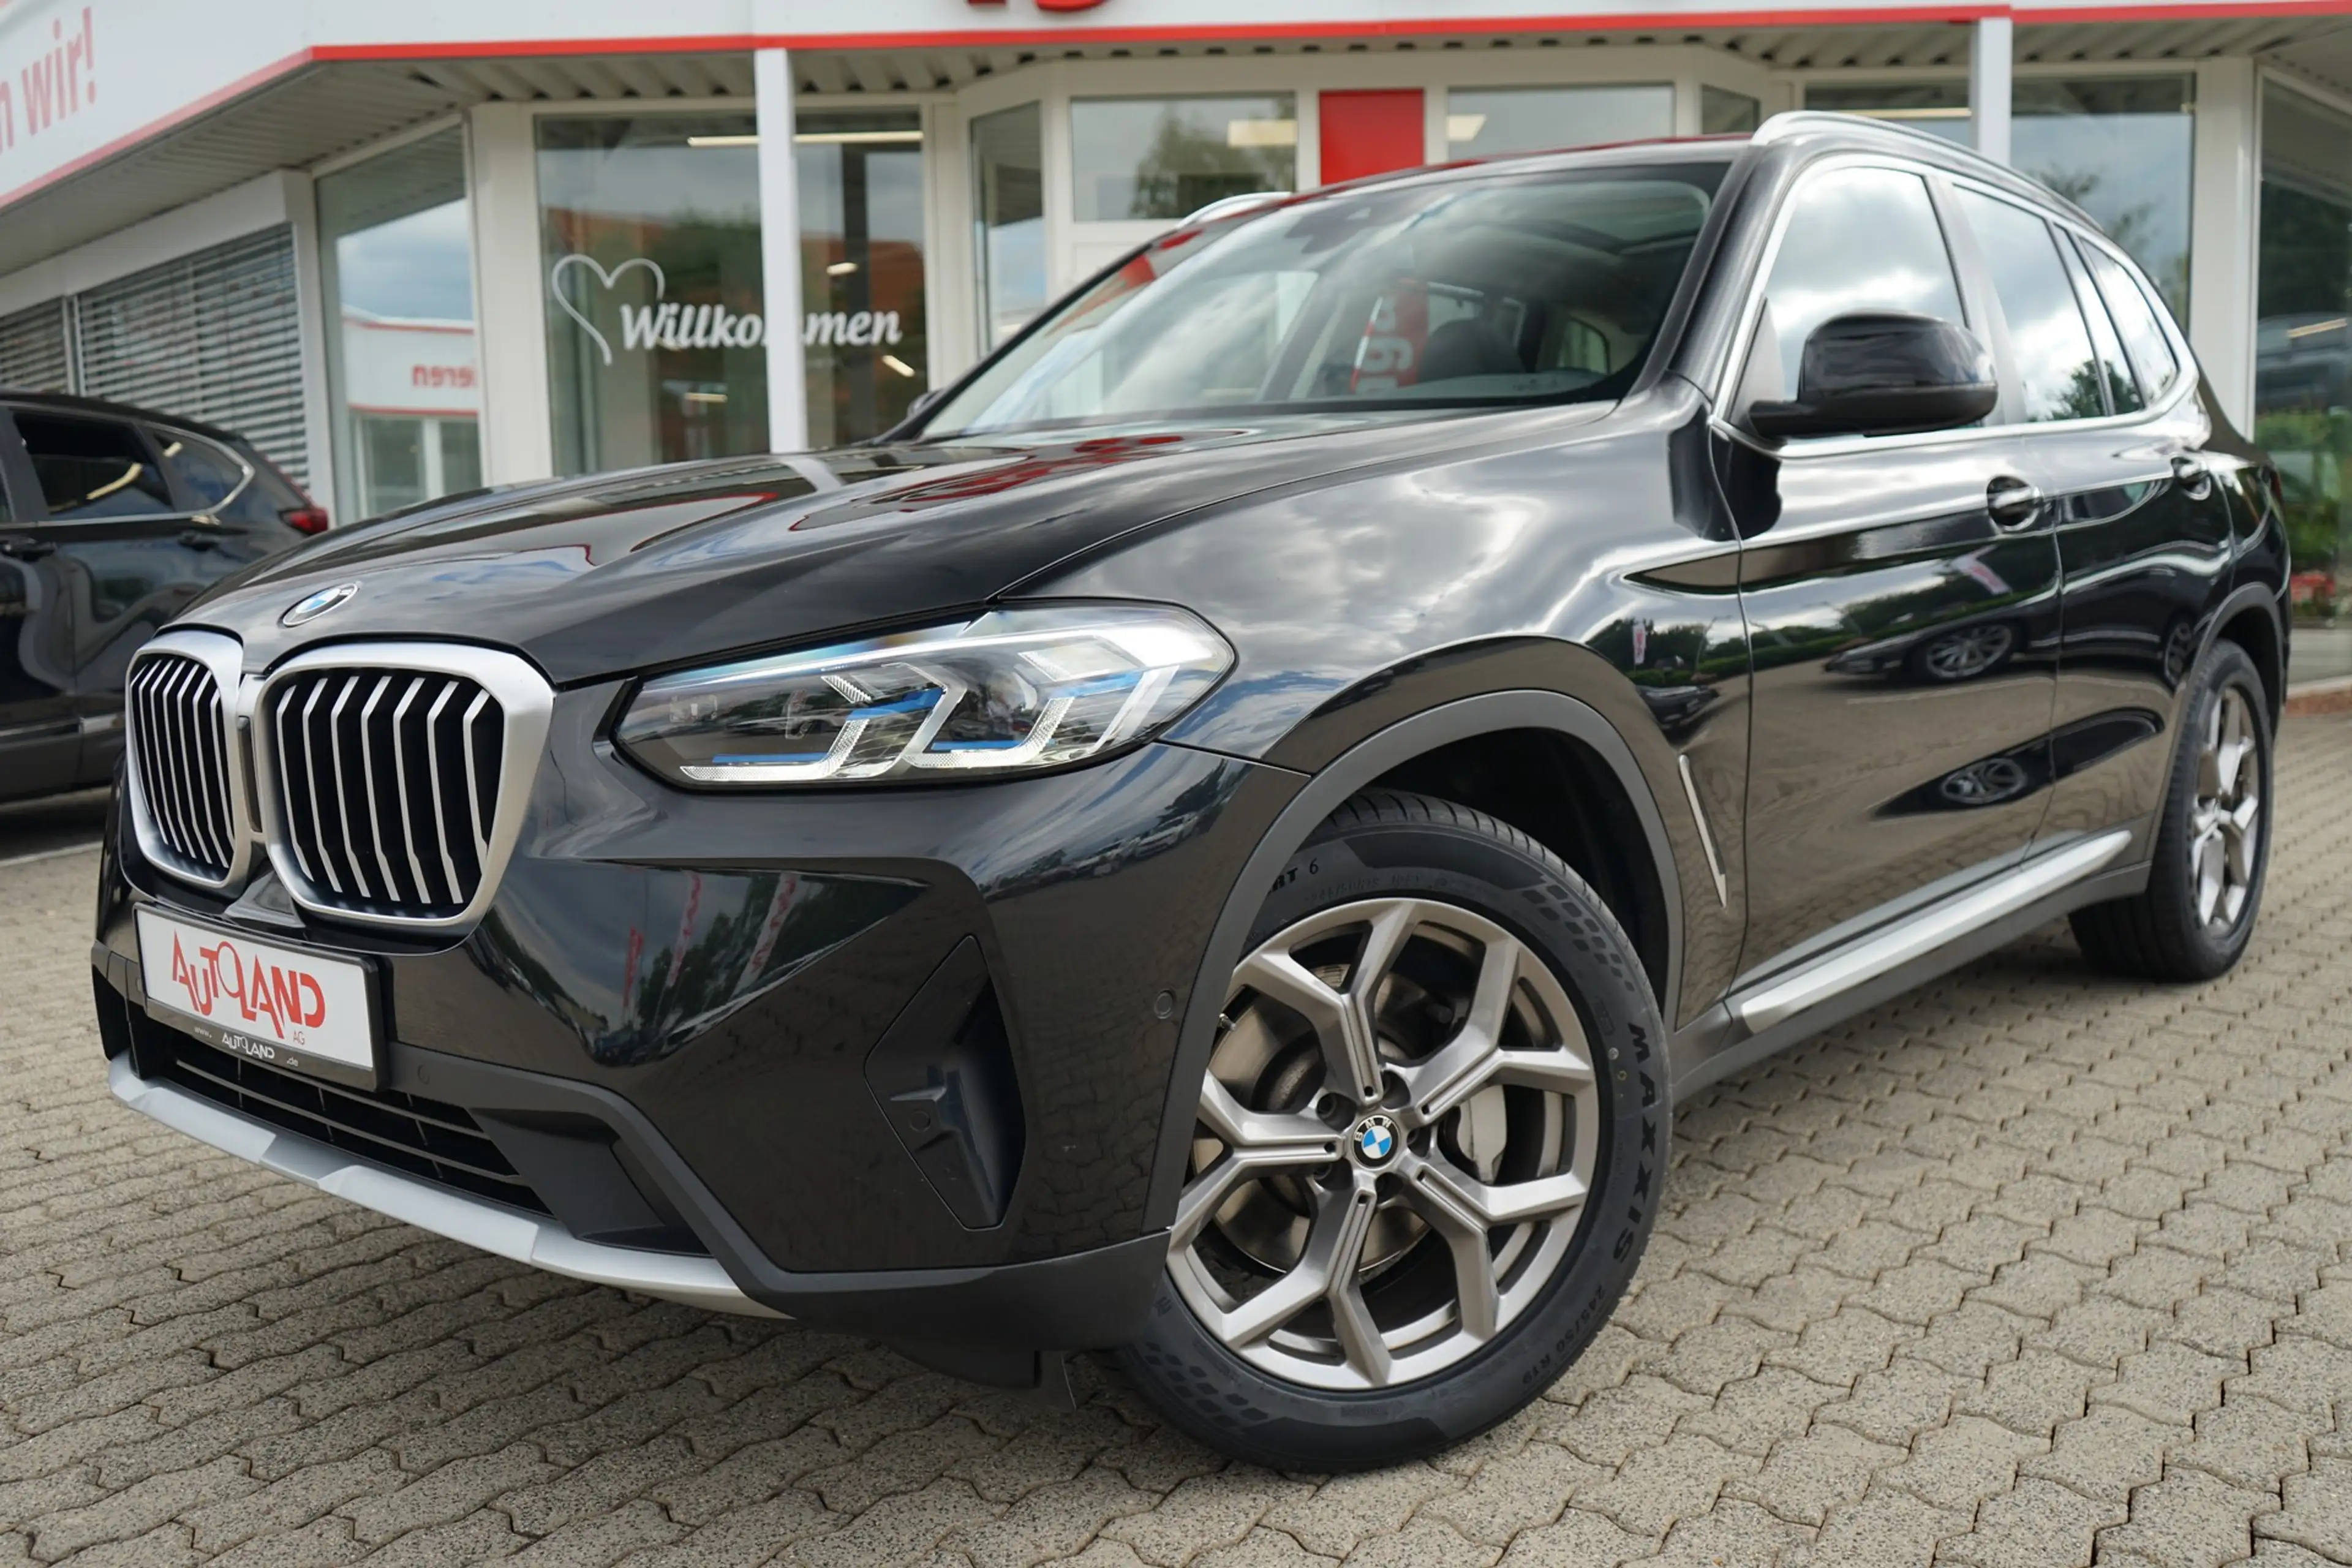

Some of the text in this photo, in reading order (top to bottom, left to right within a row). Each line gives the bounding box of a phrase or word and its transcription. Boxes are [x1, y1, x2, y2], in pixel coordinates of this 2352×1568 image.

[21, 6, 96, 137] wir!
[620, 303, 903, 350] Willkomen
[1309, 858, 1319, 875] 6
[172, 928, 326, 1039] AUTOLAND
[293, 1031, 305, 1046] AG
[1354, 1117, 1392, 1142] BMW
[1613, 1022, 1657, 1264] MAXXIS
